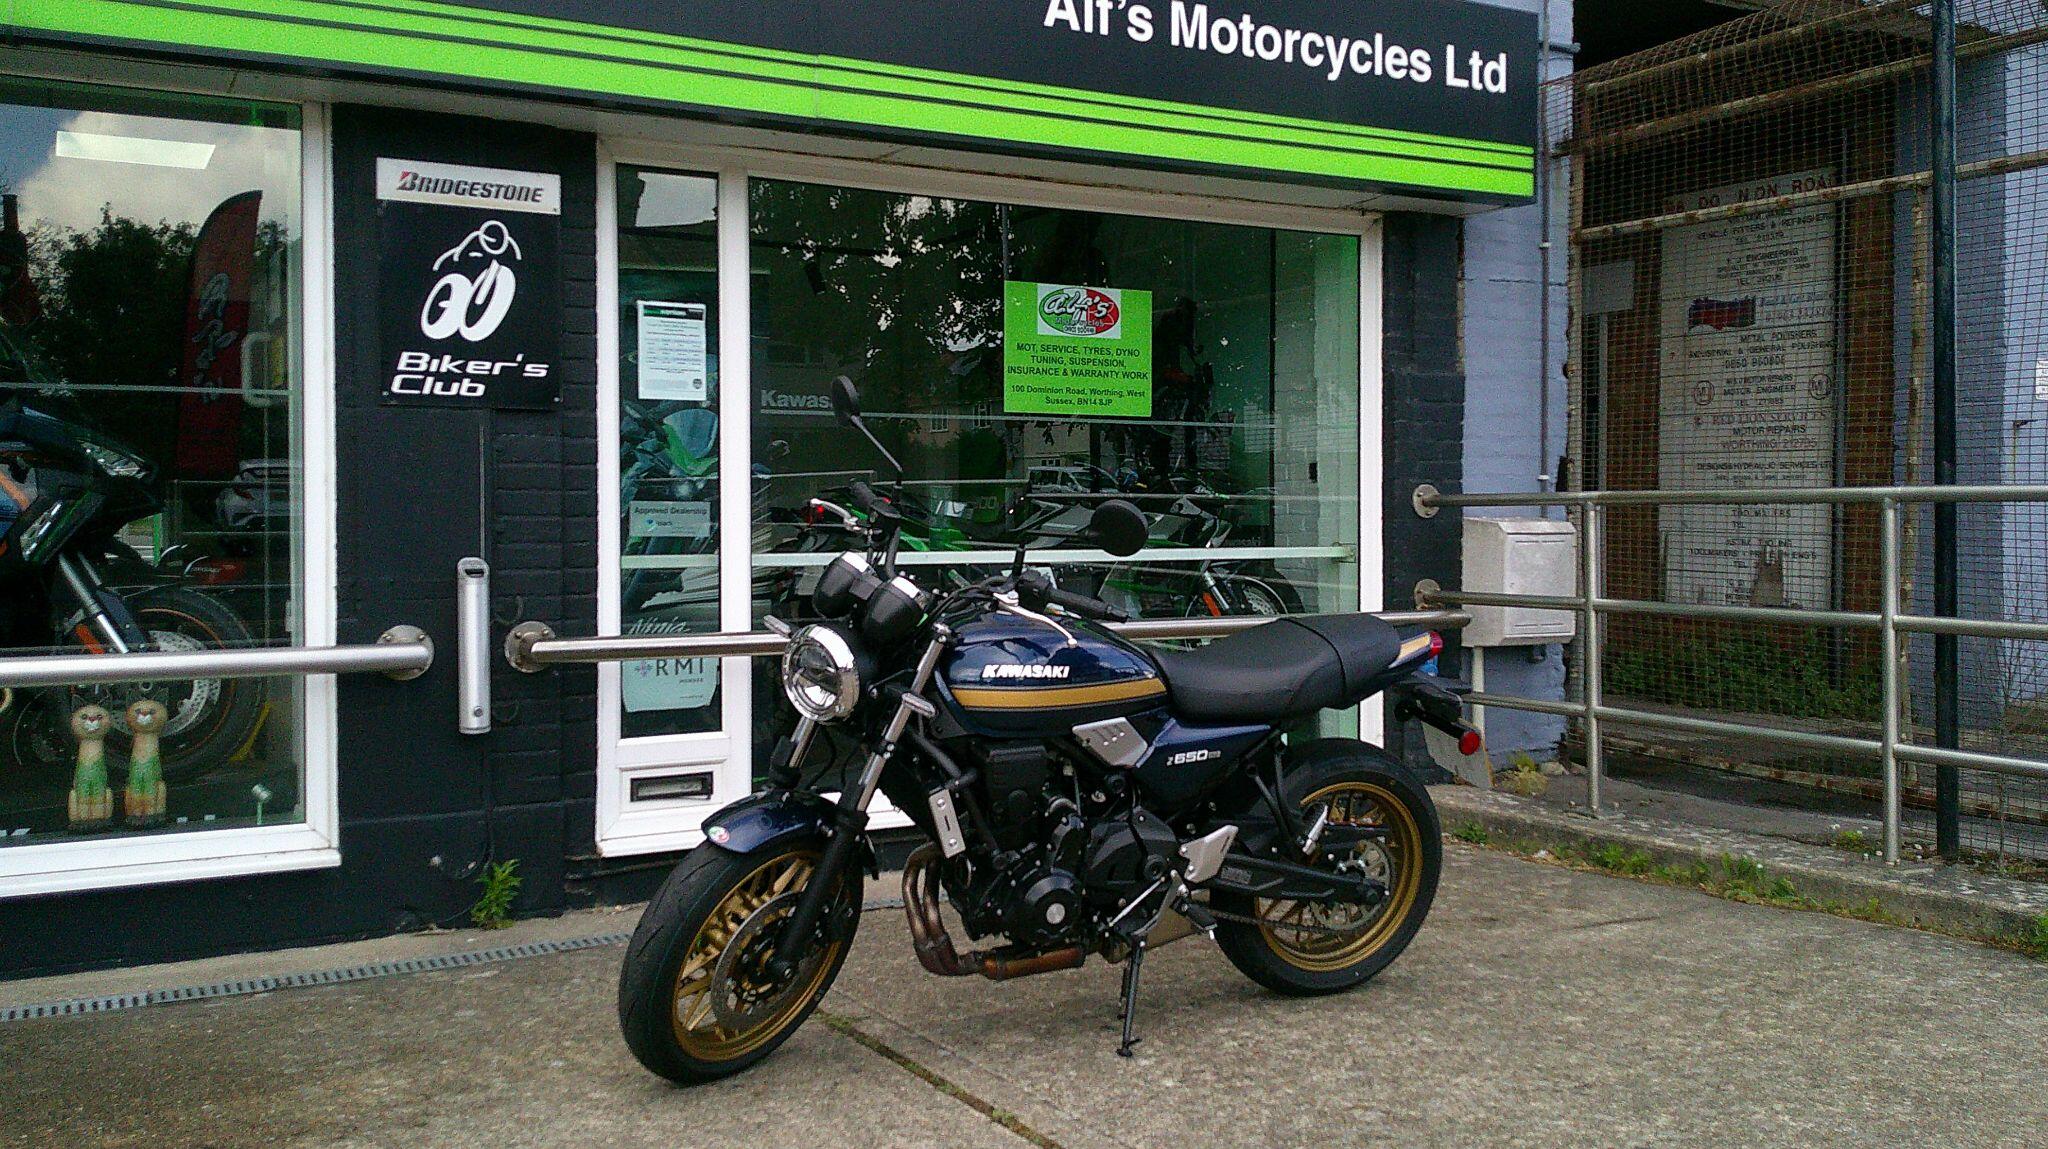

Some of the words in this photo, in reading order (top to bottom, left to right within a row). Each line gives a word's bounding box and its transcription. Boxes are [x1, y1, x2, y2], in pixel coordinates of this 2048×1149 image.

[1043, 0, 1155, 42] Alf's
[1170, 0, 1432, 82] Motorcycles
[1445, 43, 1507, 94] Ltd
[396, 170, 545, 204] BRIDGESTONE
[1016, 342, 1038, 353] MOT,
[1083, 346, 1114, 357] TYRES,
[1116, 347, 1140, 358] DYNO
[397, 351, 549, 378] Biker's
[1031, 355, 1067, 366] TUNING,
[1069, 356, 1127, 369] SUSPENSION,
[1007, 365, 1059, 377] INSURANCE
[1062, 367, 1069, 377] &
[1071, 368, 1120, 379] WARRANTY
[1122, 371, 1149, 381] WORK
[390, 374, 486, 397] Club
[1011, 385, 1025, 393] 100
[1027, 385, 1063, 395] Dominion
[1127, 389, 1146, 398] West
[1045, 397, 1076, 406] Sussex,
[1077, 398, 1097, 407] BN14
[629, 616, 688, 634] Ninja
[656, 659, 703, 676] RMI
[982, 664, 1070, 679] KAWASAKI
